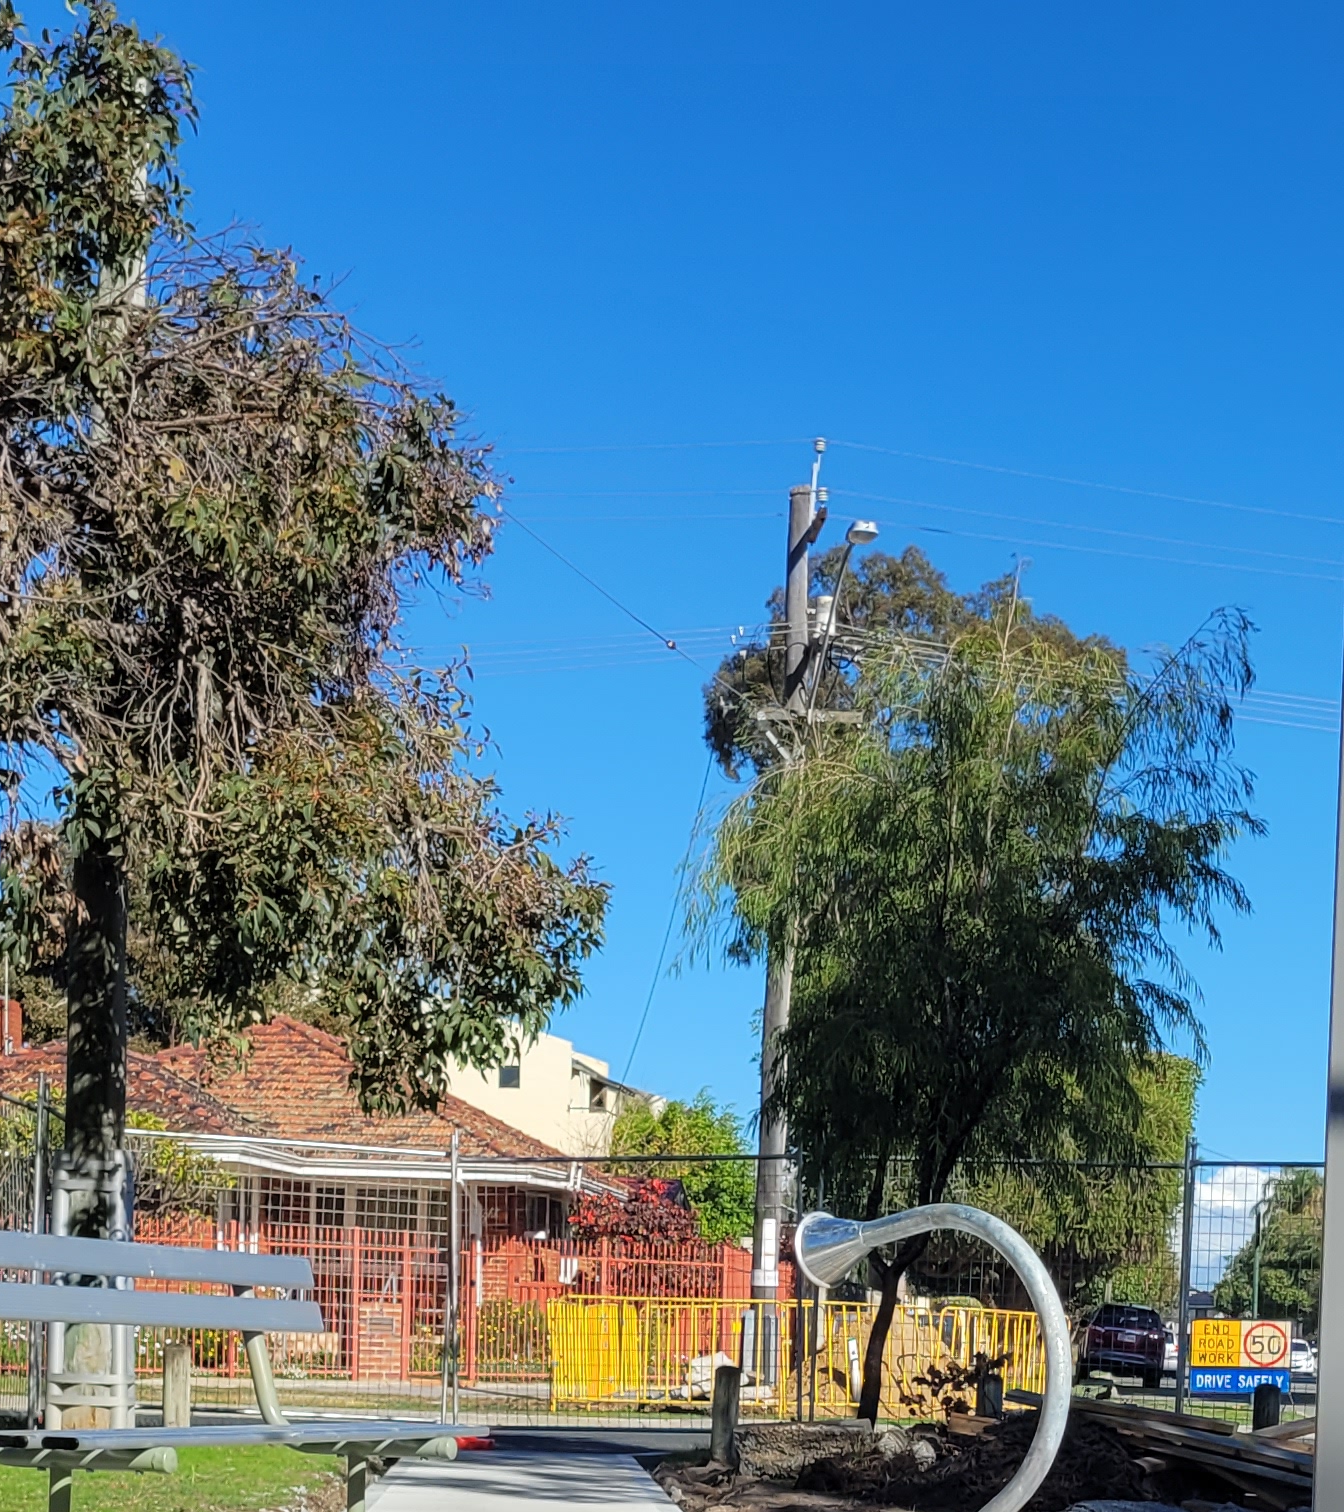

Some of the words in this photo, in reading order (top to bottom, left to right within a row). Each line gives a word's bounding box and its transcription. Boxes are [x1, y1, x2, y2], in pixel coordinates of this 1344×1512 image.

[1204, 1324, 1230, 1335] END
[1199, 1338, 1234, 1349] ROAD
[1251, 1335, 1281, 1355] 50
[1199, 1353, 1235, 1363] WORK
[1196, 1374, 1232, 1388] DRIVE
